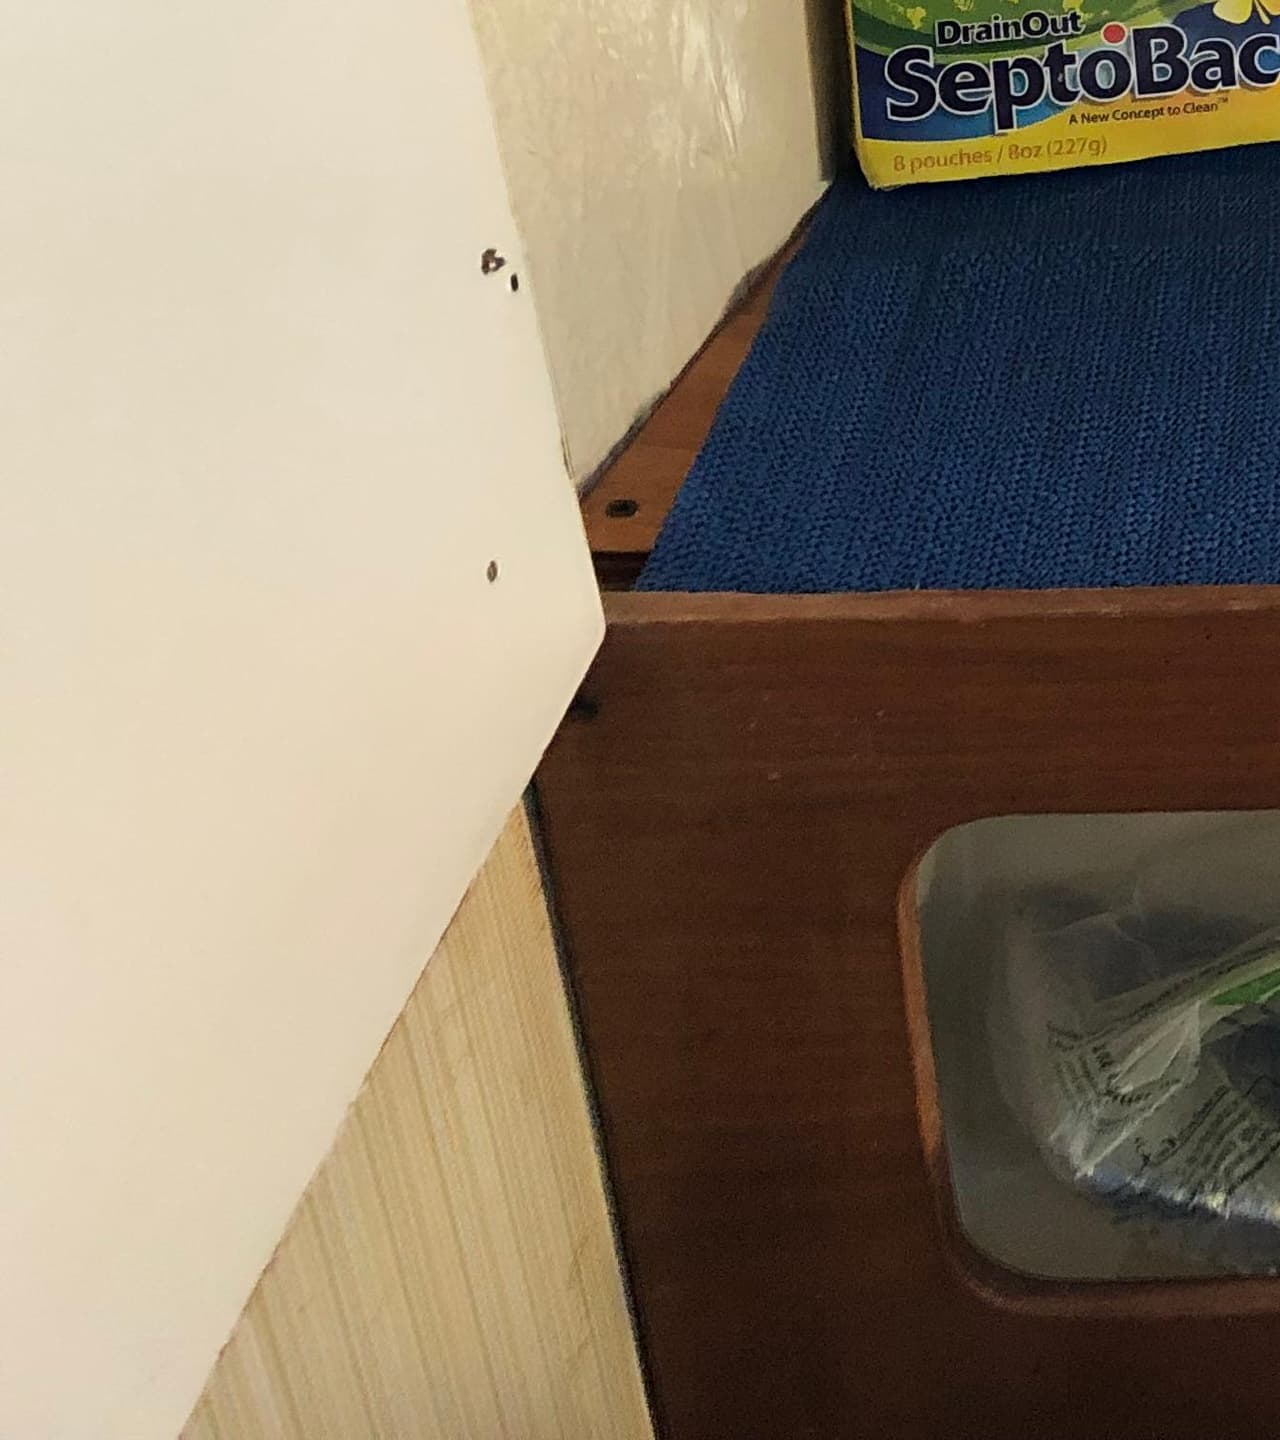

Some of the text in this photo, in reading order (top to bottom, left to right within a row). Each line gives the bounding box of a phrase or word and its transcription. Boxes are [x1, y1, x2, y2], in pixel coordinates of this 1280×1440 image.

[936, 11, 1085, 47] DrainOut
[1069, 112, 1079, 125] A
[1081, 111, 1109, 124] New
[1112, 106, 1165, 123] Concept
[1167, 105, 1181, 116] to
[894, 155, 905, 172] 8
[910, 148, 993, 173] pouches
[1008, 143, 1043, 160] 8oz
[1046, 136, 1109, 158] (227g)
